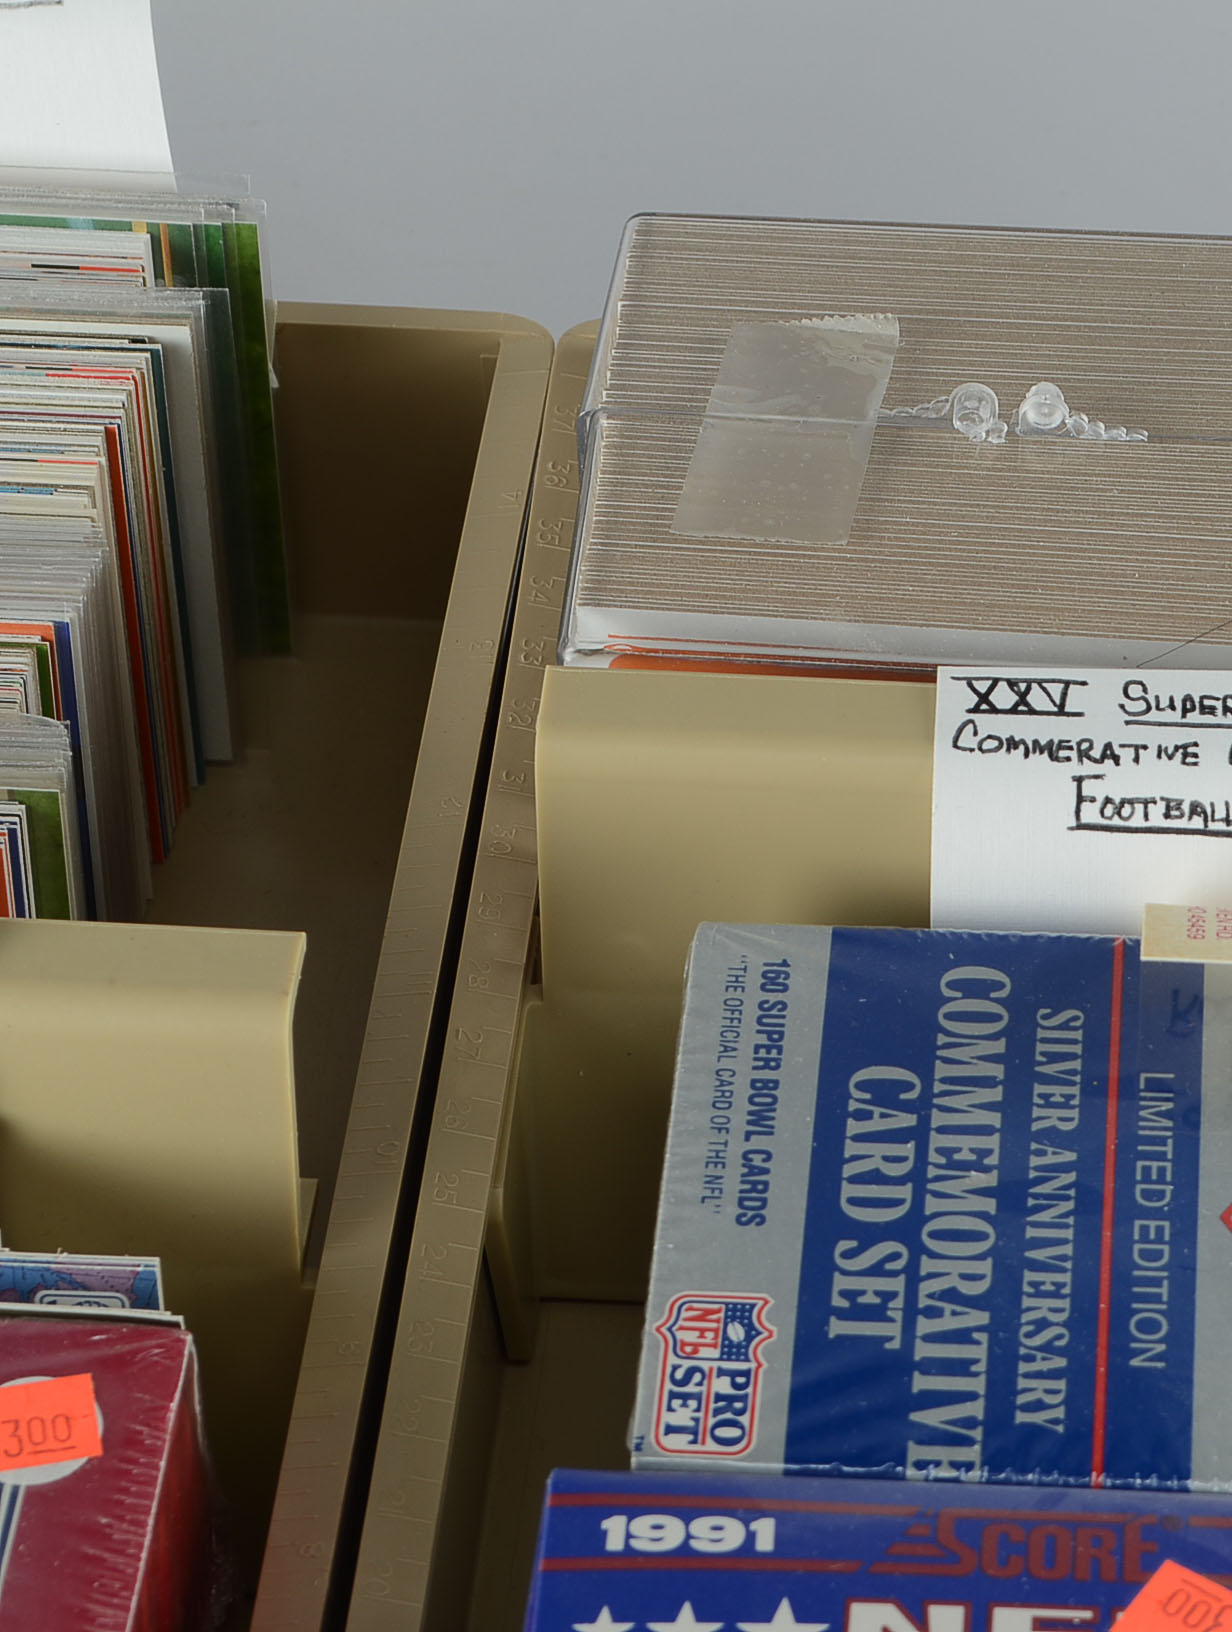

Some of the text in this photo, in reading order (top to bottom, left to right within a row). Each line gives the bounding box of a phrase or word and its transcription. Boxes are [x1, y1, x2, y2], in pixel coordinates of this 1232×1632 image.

[951, 676, 1088, 716] XXV
[952, 719, 1200, 767] COMMERATIVE
[717, 997, 745, 1063] OFFICIAL
[709, 1114, 731, 1135] OF
[711, 1067, 737, 1112] CARD
[735, 958, 791, 1227] 160 SUPER BOWL CARDS
[705, 1139, 729, 1170] THE
[828, 1065, 922, 1350] CARD SET
[905, 965, 1012, 1484] COMMEMORATIVE
[1014, 1008, 1086, 1434] SILVER ANNIVERSARY
[1128, 1072, 1175, 1369] LIMITED EDITION
[675, 1305, 723, 1357] NFL
[664, 1363, 707, 1445] SET
[710, 1365, 752, 1447] PRO
[601, 1514, 775, 1553] 1991
[868, 1506, 1161, 1584] SCORE
